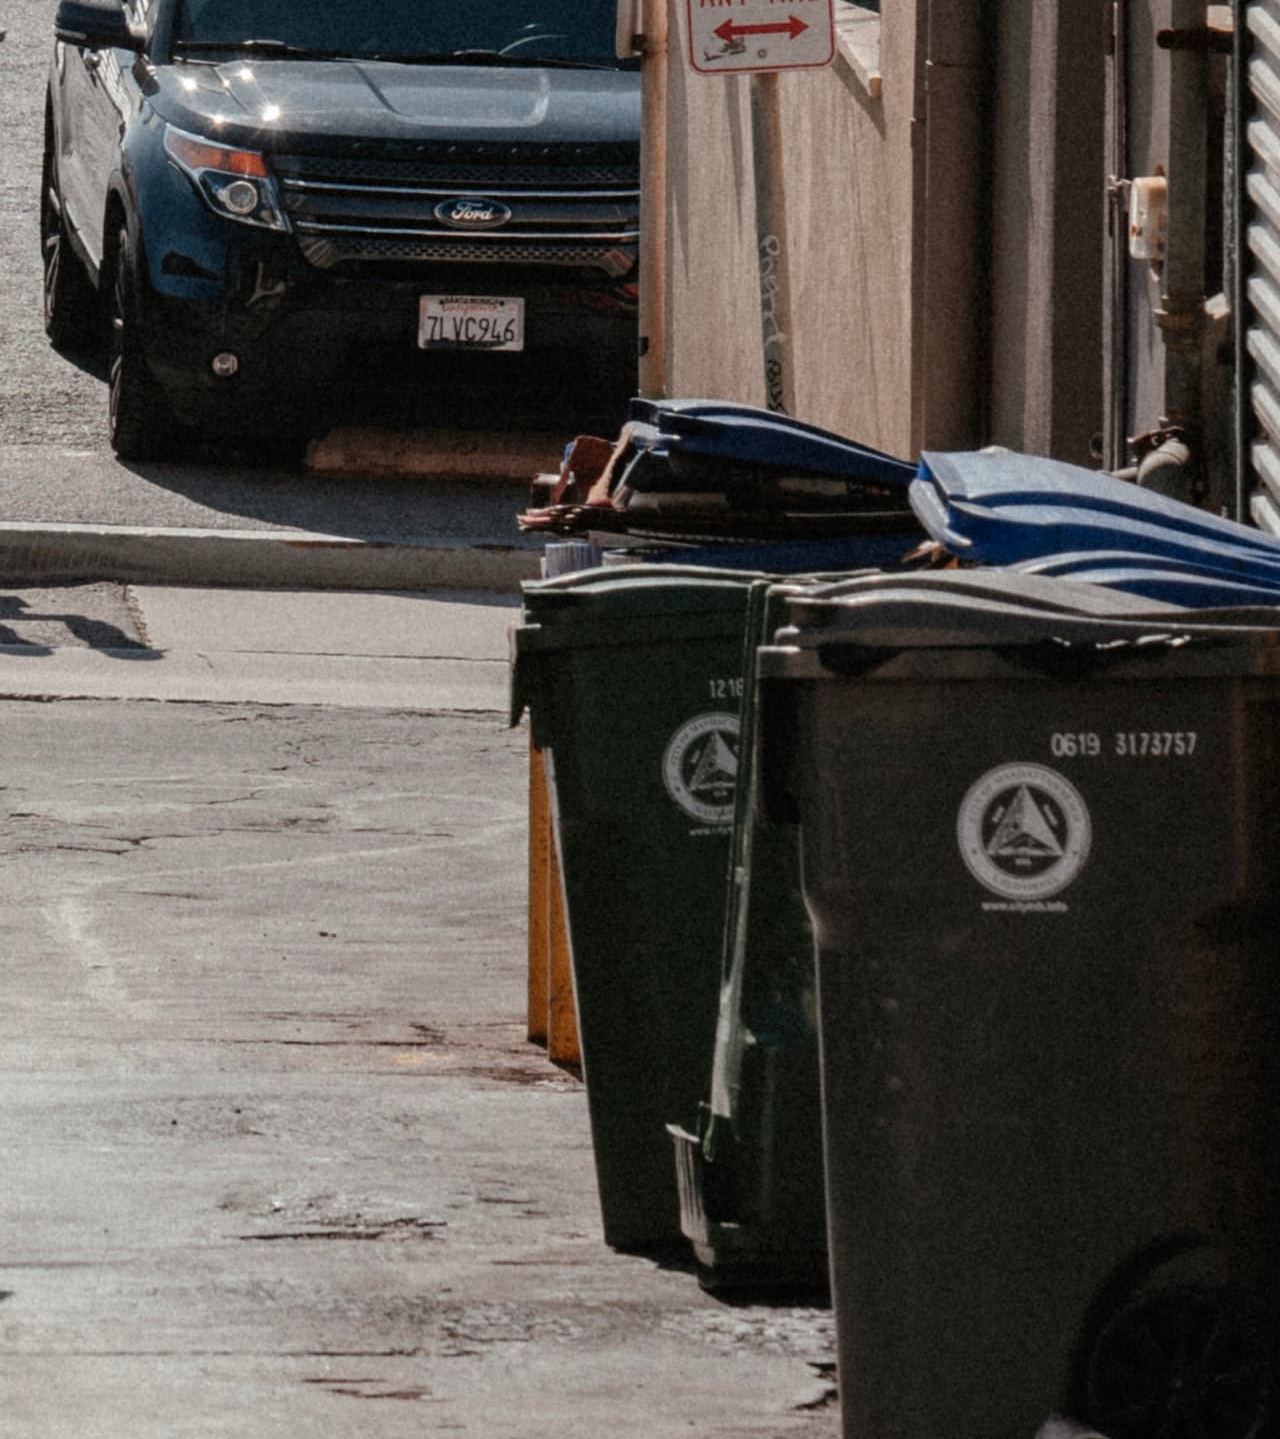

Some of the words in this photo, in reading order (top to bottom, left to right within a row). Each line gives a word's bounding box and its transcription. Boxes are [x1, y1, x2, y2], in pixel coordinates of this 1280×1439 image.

[451, 202, 493, 220] Ford
[427, 315, 515, 342] 7LVC946
[1050, 732, 1101, 756] 0619
[1115, 732, 1197, 756] 3173757
